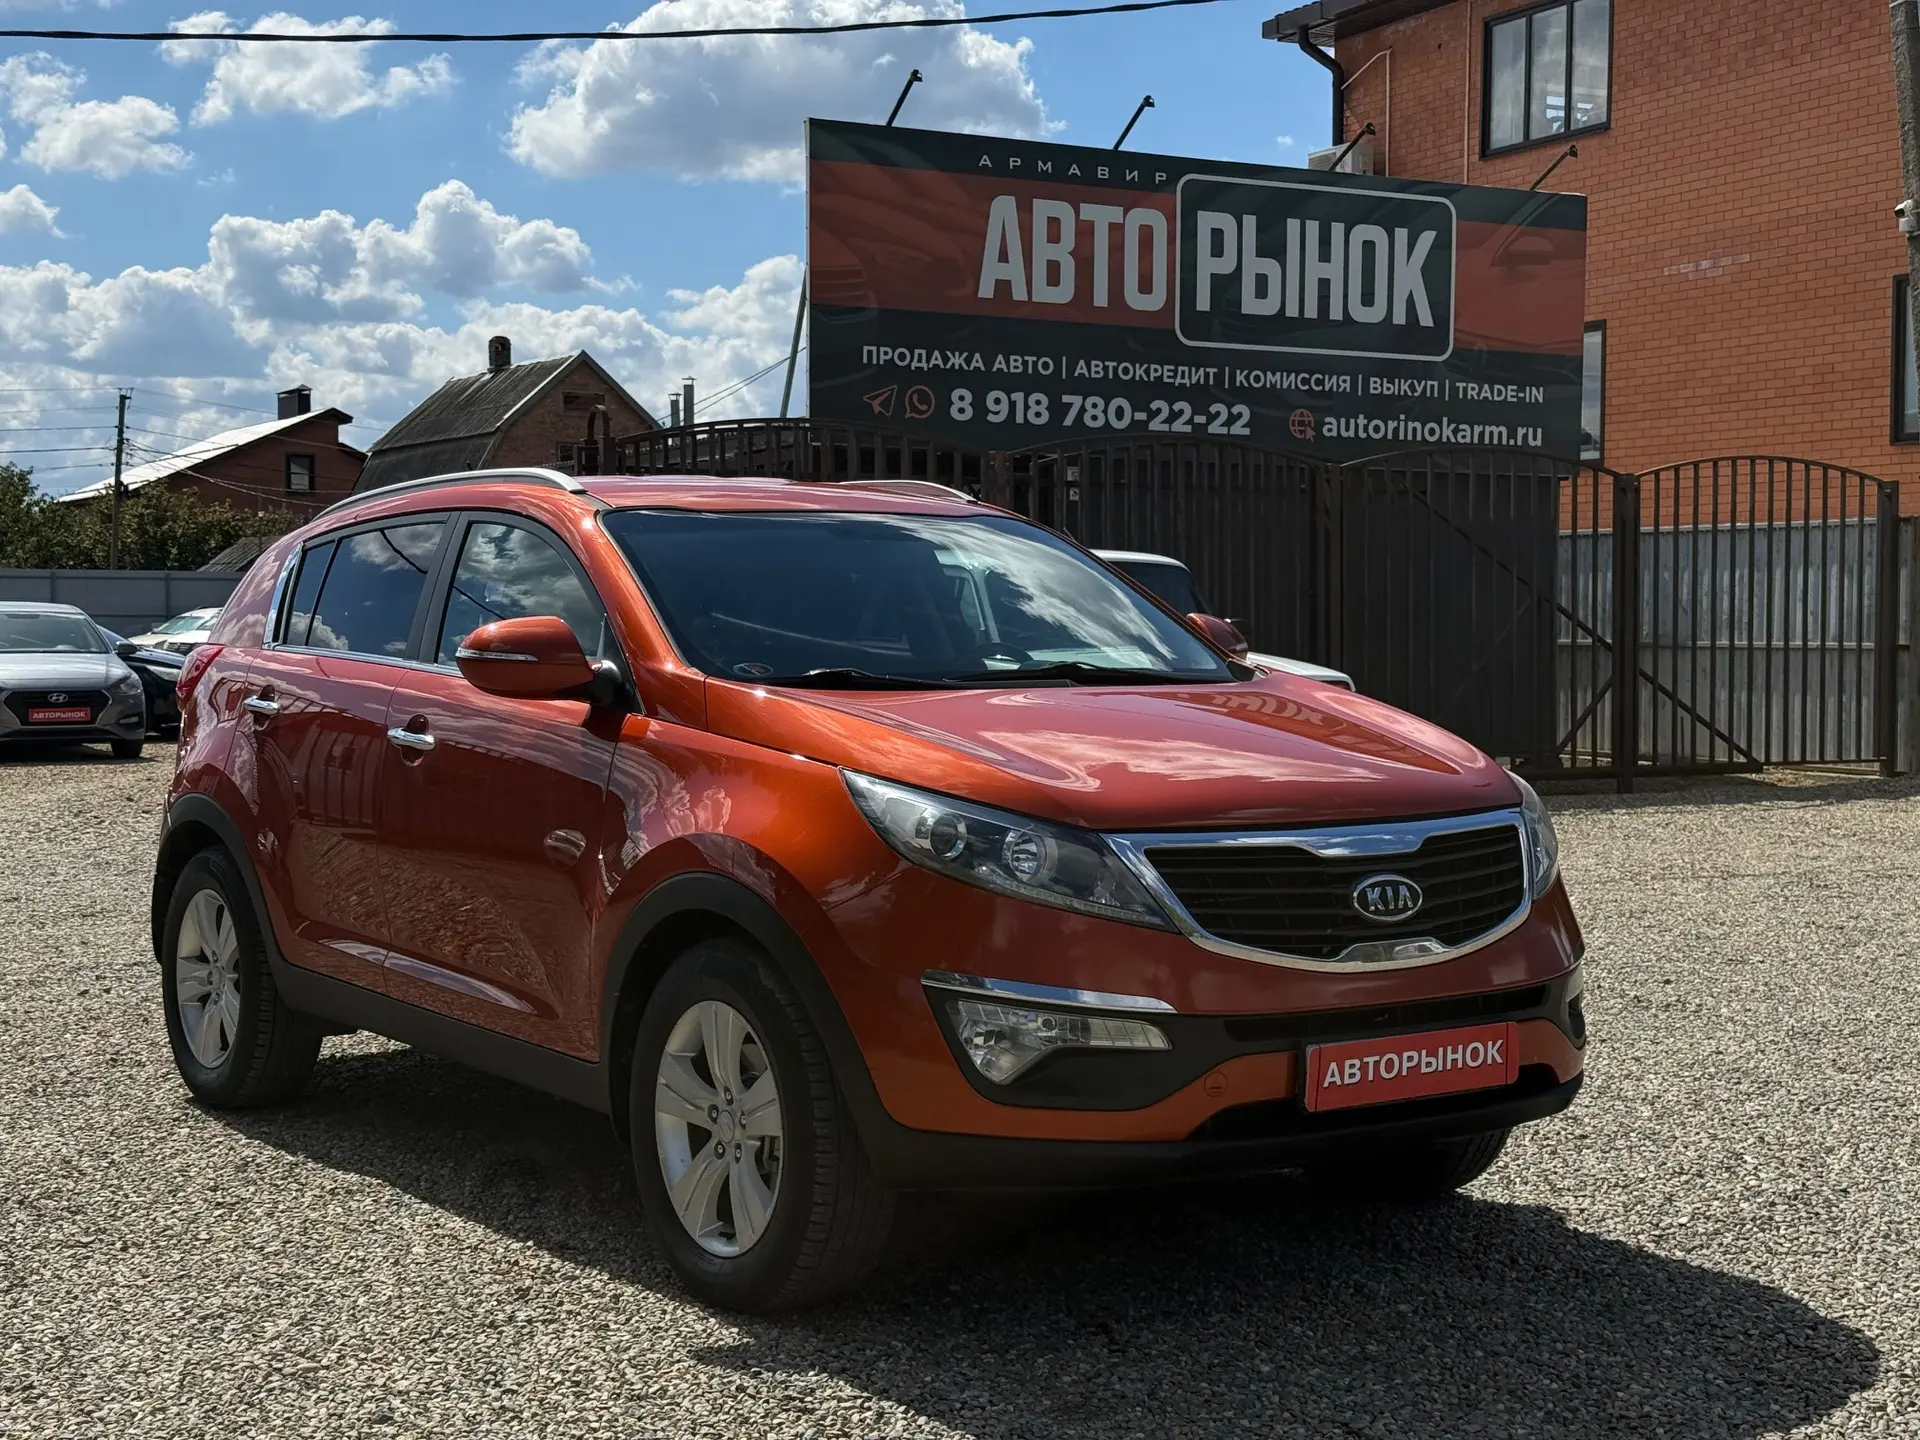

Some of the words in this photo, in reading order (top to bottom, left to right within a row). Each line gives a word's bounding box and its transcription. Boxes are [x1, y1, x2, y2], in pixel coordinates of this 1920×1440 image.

[978, 155, 1167, 184] АРМАВИР
[862, 345, 986, 372] ПРОДАЖА
[992, 354, 1054, 376] АВТО
[1073, 359, 1218, 387] АВТОКРЕДИТ
[1235, 369, 1350, 393] КОМИССИЯ
[1369, 378, 1438, 398] ВЫКУП
[1456, 382, 1544, 403] TRADE-IN
[949, 388, 974, 421] 8
[985, 390, 1050, 425] 918
[1061, 394, 1251, 436] 780-22-22
[1322, 413, 1543, 447] autorinokarm.ru
[32, 711, 86, 719] АВТОРЫНОК
[1365, 884, 1414, 912] KIA
[1323, 1039, 1504, 1088] АВТОРЫНОК
